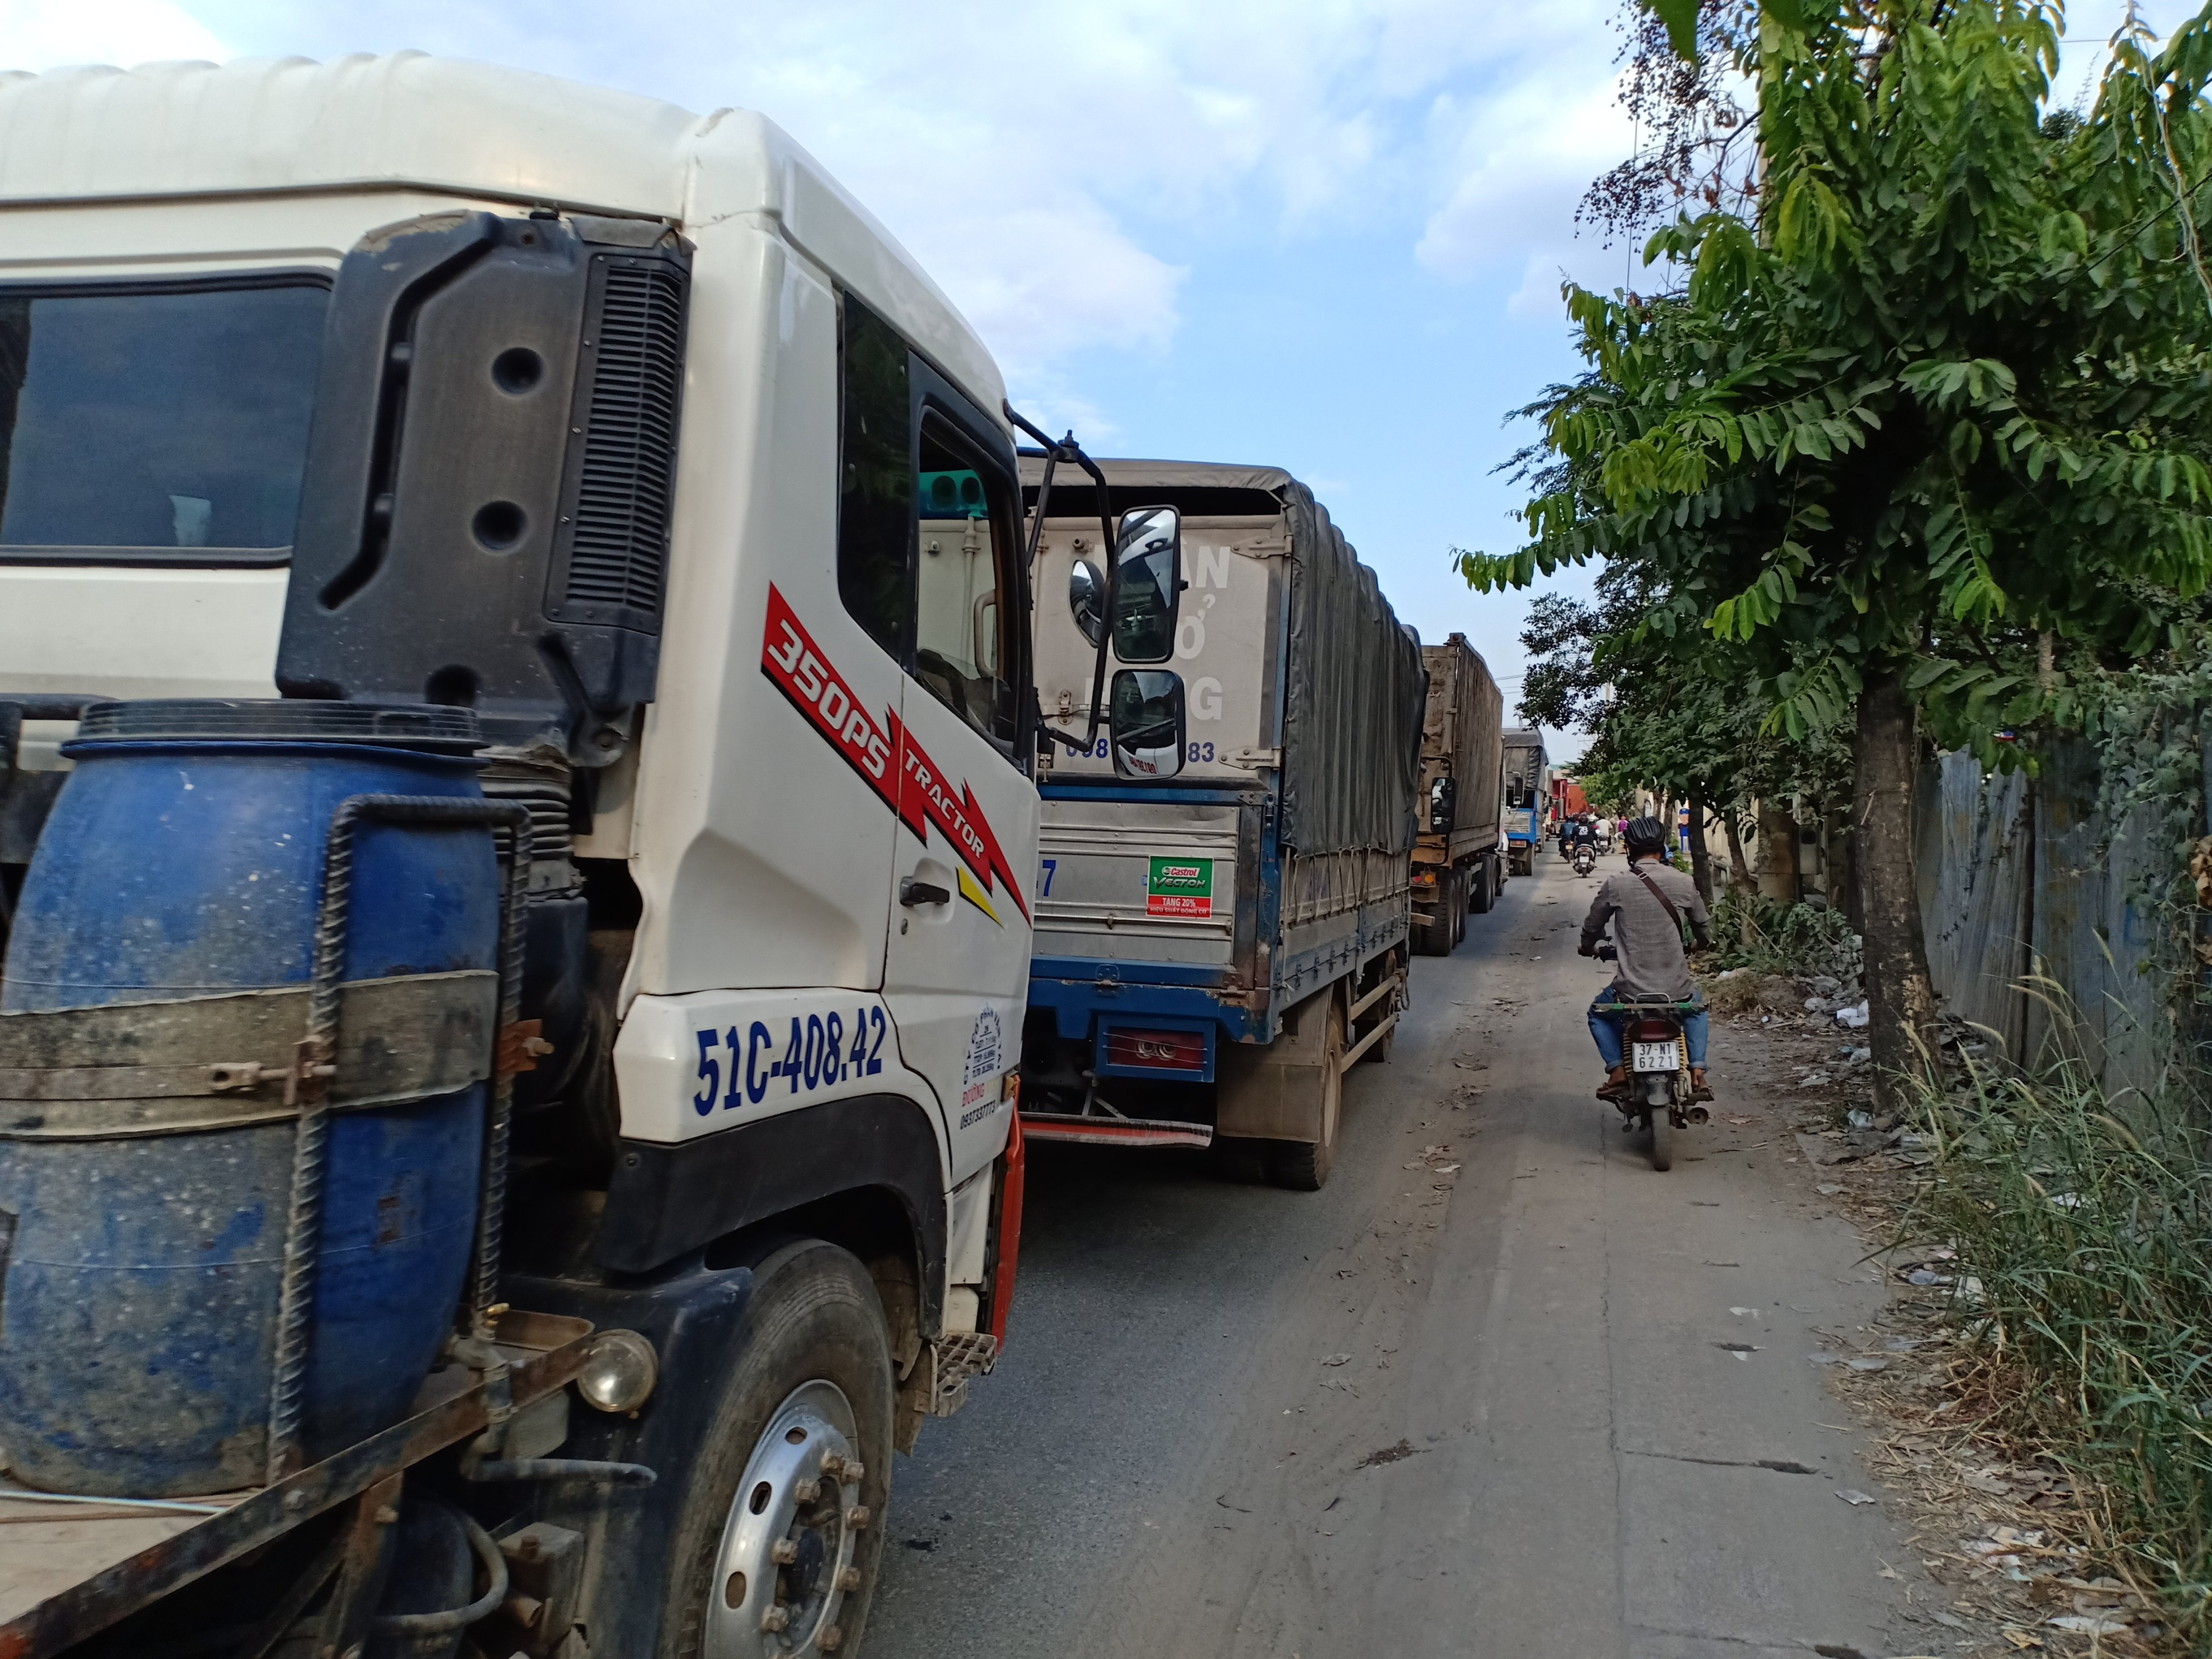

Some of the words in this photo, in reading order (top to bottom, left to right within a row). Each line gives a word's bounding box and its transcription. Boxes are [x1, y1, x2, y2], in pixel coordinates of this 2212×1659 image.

[767, 618, 891, 779] 350PS
[905, 747, 984, 859] TRACTOR
[1153, 876, 1206, 889] VECTON
[1171, 868, 1197, 876] Castrol
[693, 1005, 887, 1117] 51C-408.42
[1639, 1056, 1673, 1068] 6221
